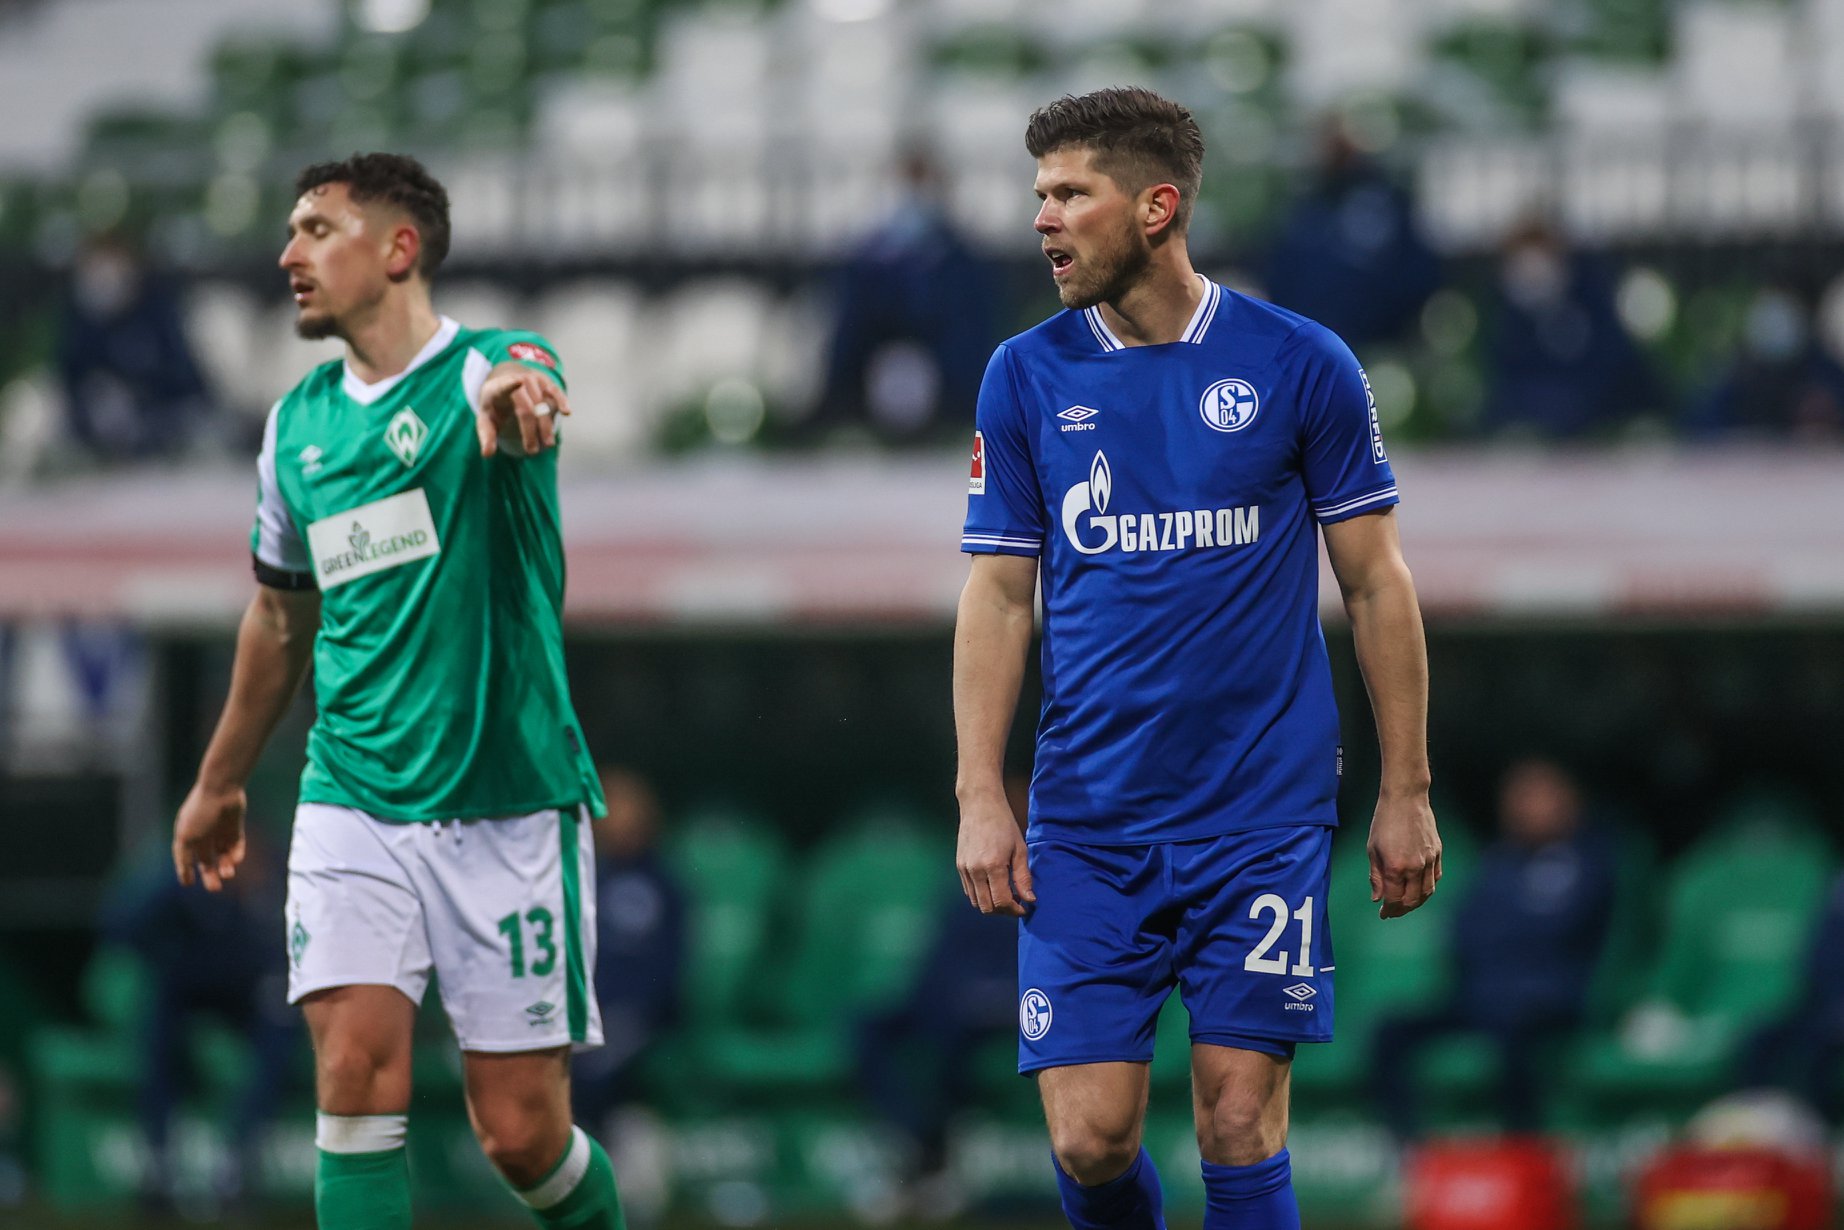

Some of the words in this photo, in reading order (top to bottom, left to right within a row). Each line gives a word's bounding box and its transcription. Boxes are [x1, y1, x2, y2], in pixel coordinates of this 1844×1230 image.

[1061, 422, 1096, 432] umbro
[1119, 505, 1259, 552] GAZPROM
[498, 905, 557, 978] 13
[1244, 893, 1314, 977] 21
[1284, 1001, 1314, 1011] umbro
